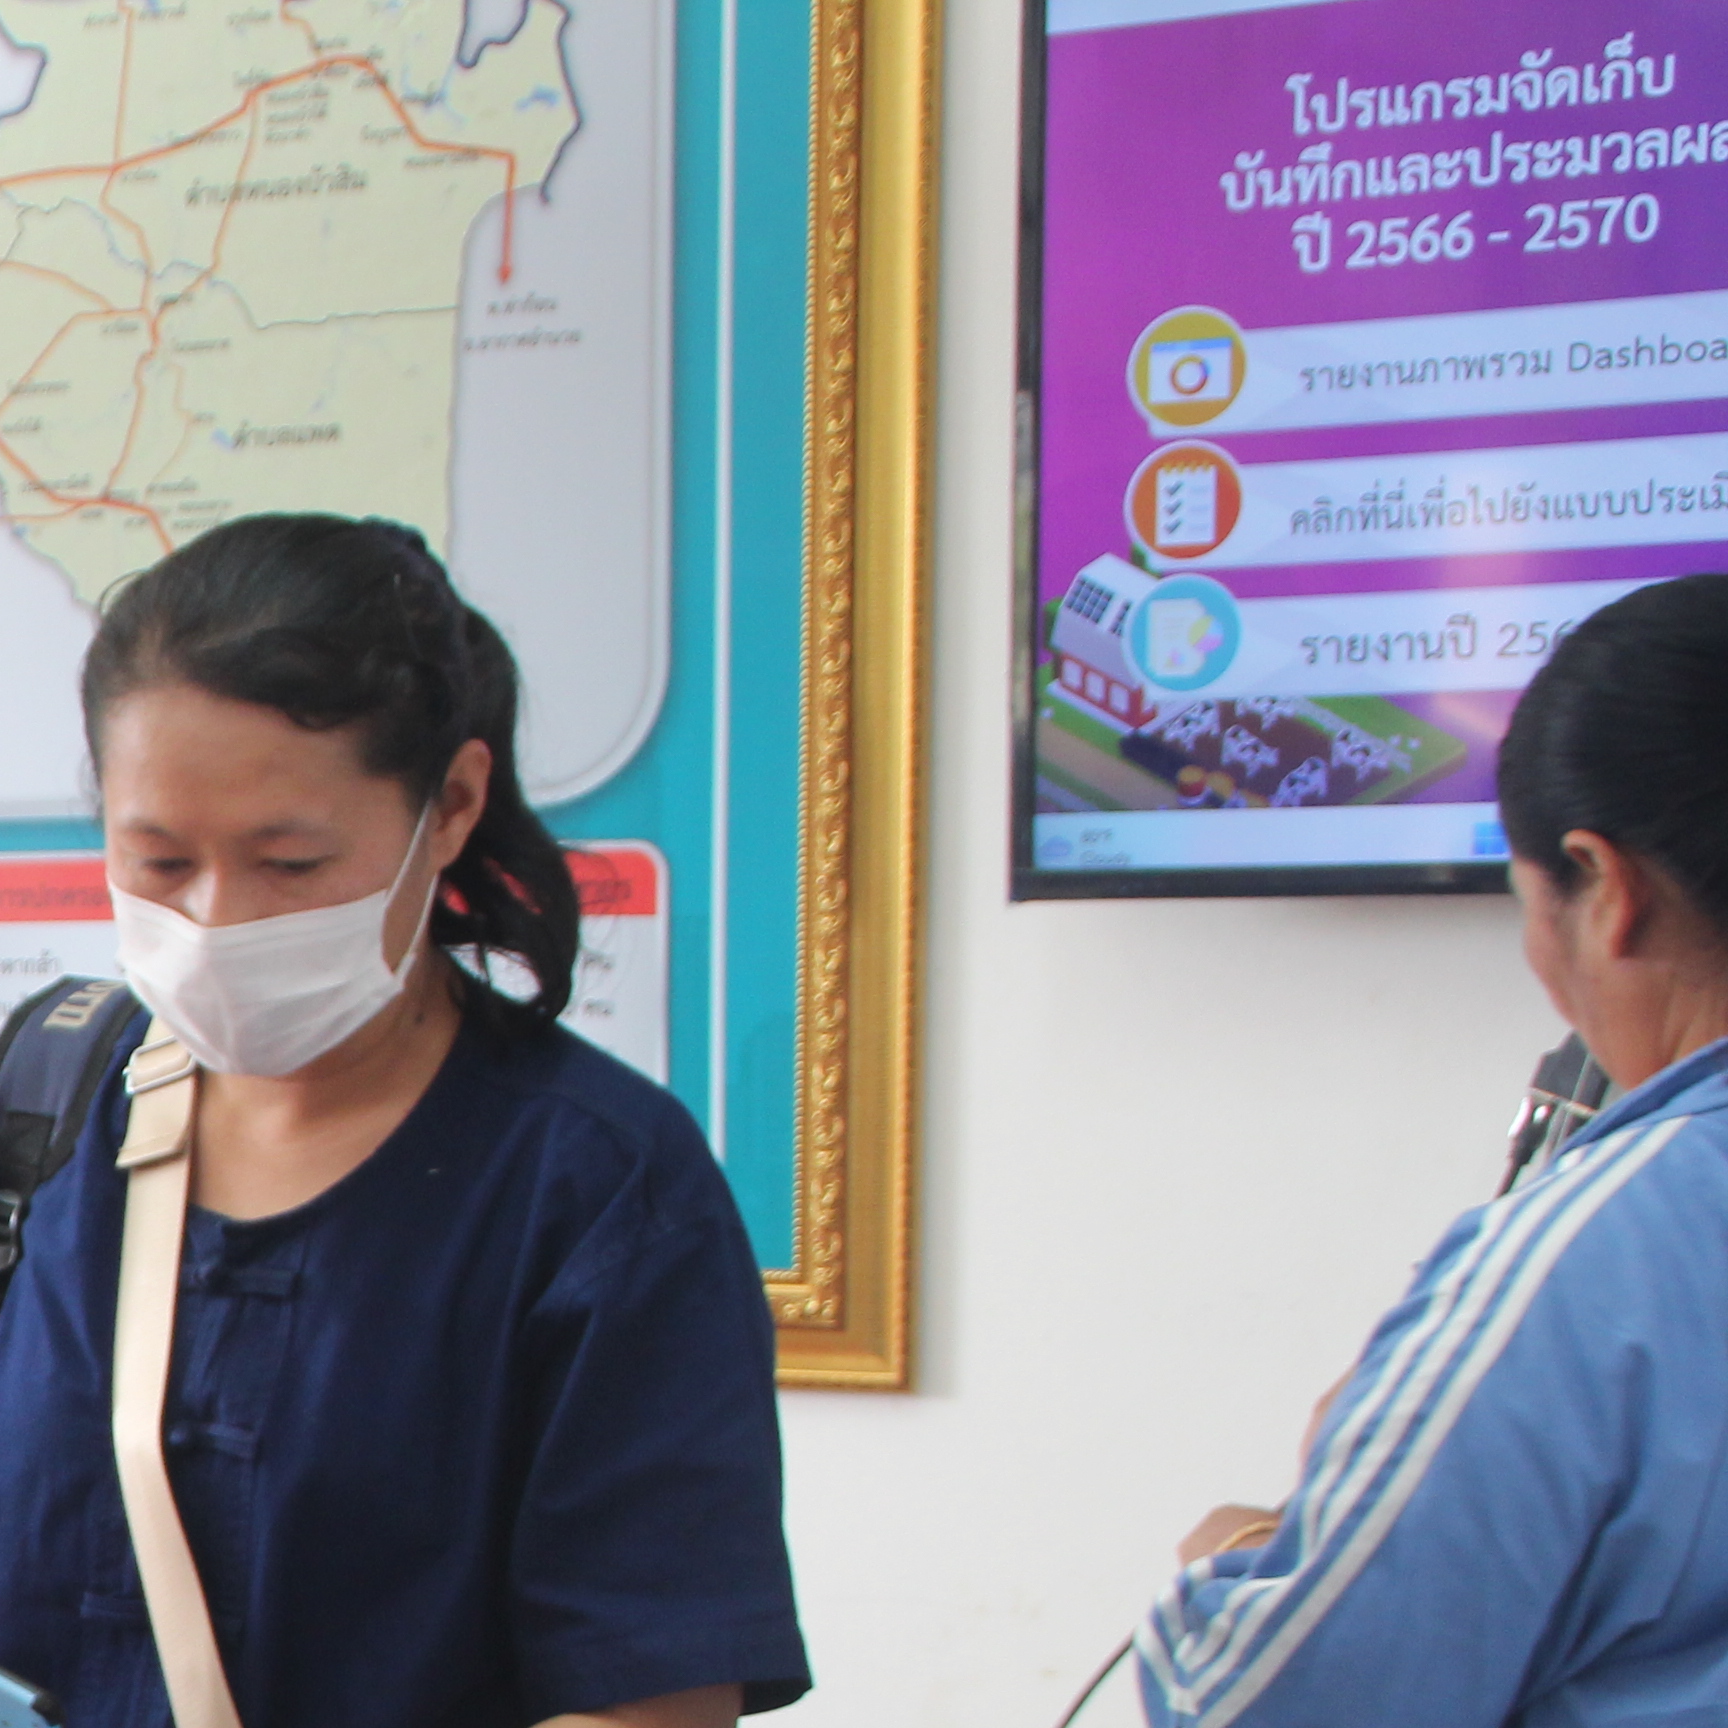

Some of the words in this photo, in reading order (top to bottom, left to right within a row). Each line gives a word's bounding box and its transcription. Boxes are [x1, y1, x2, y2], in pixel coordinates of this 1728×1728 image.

[1284, 32, 1676, 137] โปรแกรมจัดเก็บ
[1290, 211, 1331, 272] ปี
[1345, 211, 1476, 271] 2566
[1486, 227, 1512, 243] -
[1523, 193, 1661, 253] 2570
[1299, 345, 1552, 392] รายงานภาพรวม
[1300, 613, 1477, 667] รายงานปี
